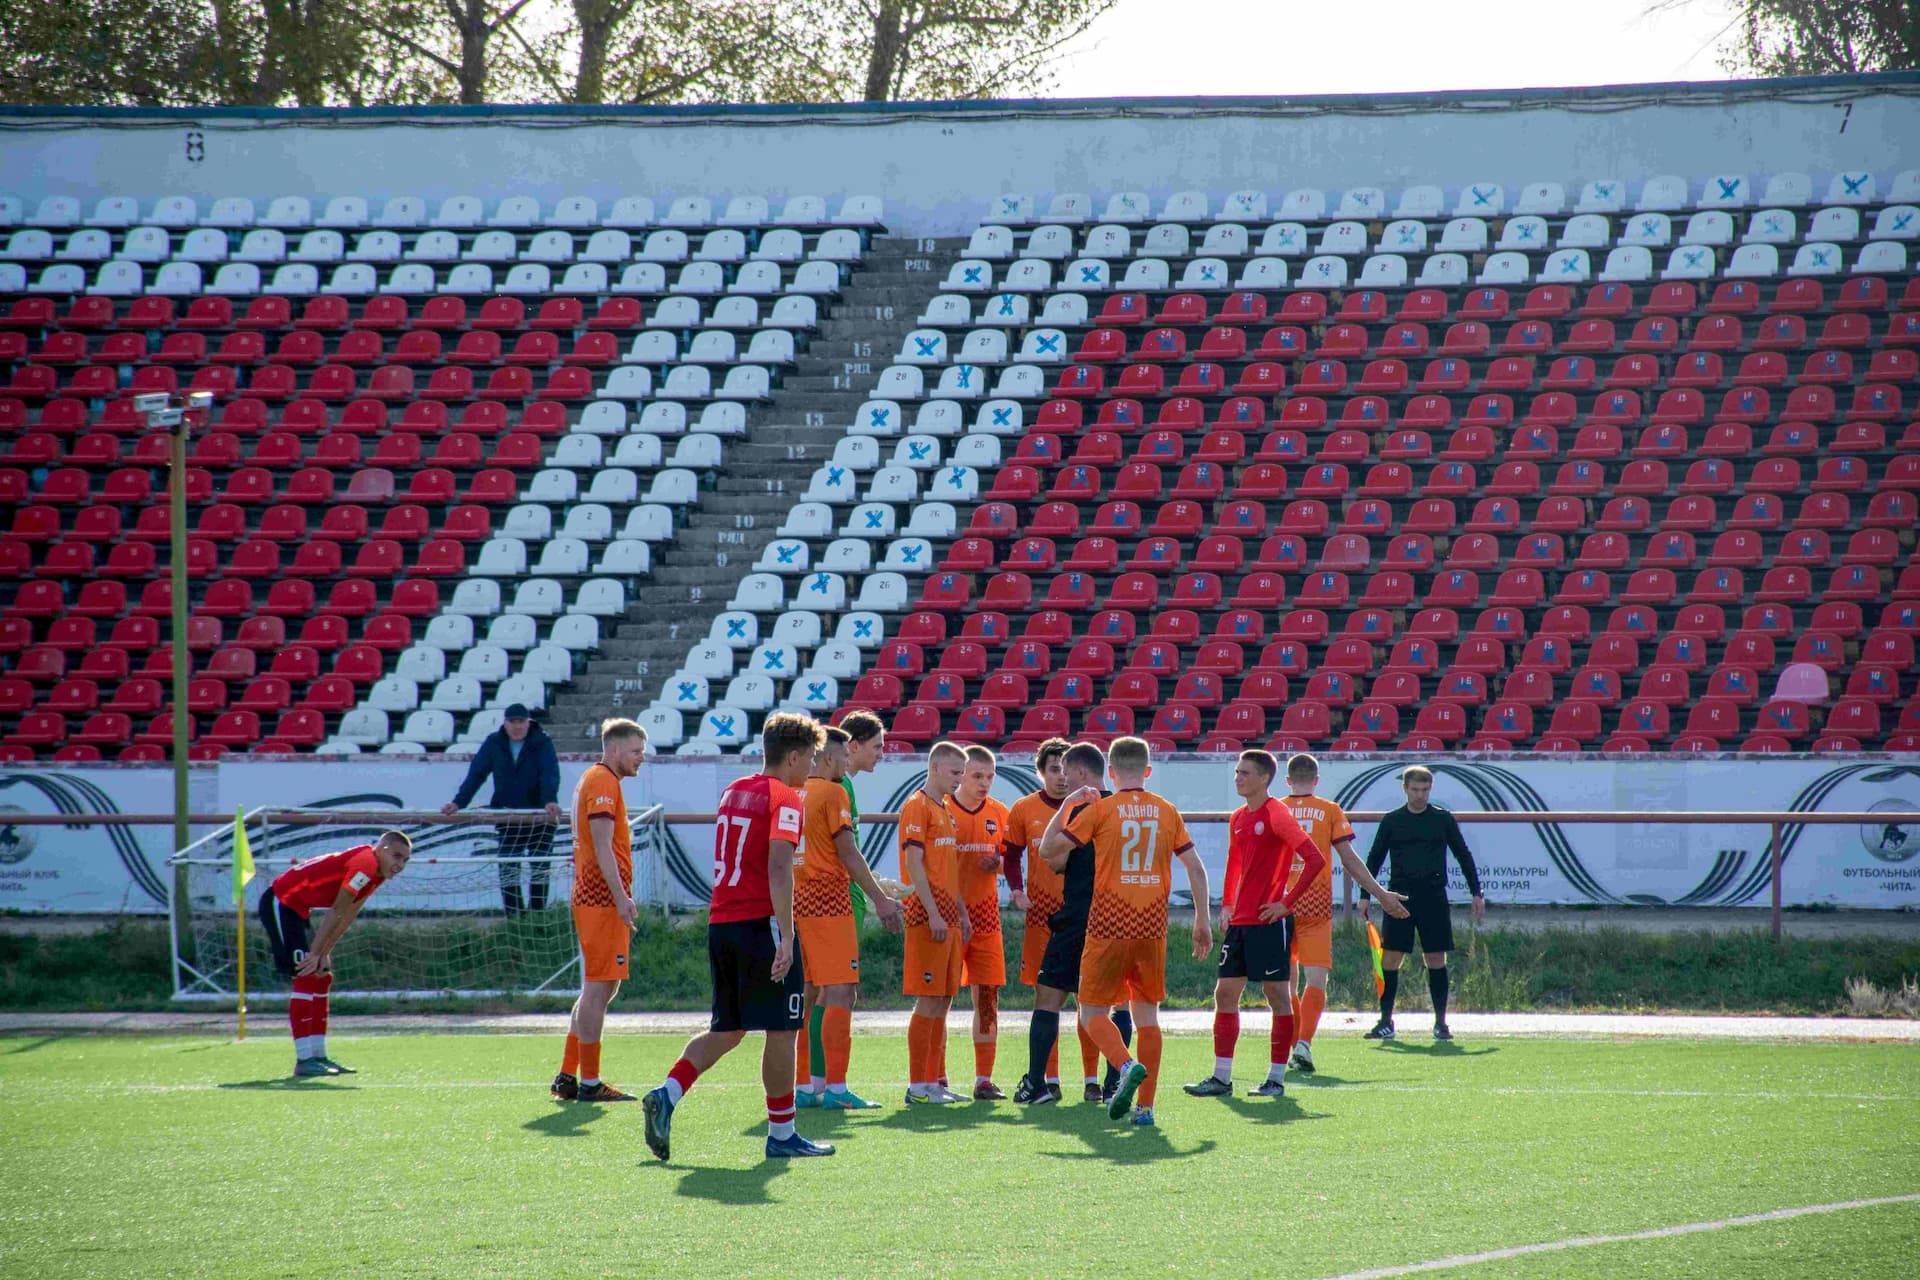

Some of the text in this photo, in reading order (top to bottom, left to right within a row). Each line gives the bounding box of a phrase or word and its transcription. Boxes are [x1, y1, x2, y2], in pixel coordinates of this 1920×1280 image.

[1833, 103, 1853, 134] 7
[186, 132, 205, 162] 8
[1339, 226, 1351, 235] 22
[917, 239, 935, 253] 18
[1023, 266, 1034, 276] 27
[1300, 295, 1312, 305] 22
[1362, 291, 1371, 303] 21
[876, 307, 893, 320] 16
[1339, 328, 1349, 337] 21
[980, 337, 991, 347] 27
[854, 343, 871, 356] 15
[895, 372, 907, 381] 28
[806, 413, 823, 427] 13
[1158, 432, 1169, 441] 23
[1279, 436, 1289, 445] 21
[786, 446, 805, 460] 12
[1134, 464, 1147, 475] 23
[1260, 469, 1271, 478] 21
[889, 475, 901, 485] 27
[767, 480, 782, 496] 11
[1052, 504, 1064, 513] 24
[1114, 503, 1126, 513] 23
[1176, 504, 1187, 514] 22
[1301, 506, 1314, 516] 20
[735, 515, 754, 527] 10
[1006, 573, 1017, 583] 24
[1194, 578, 1204, 588] 21
[1322, 577, 1334, 585] 19
[1451, 574, 1462, 585] 17
[1132, 581, 1144, 591] 22
[1259, 579, 1271, 588] 20
[919, 615, 931, 624] 25
[983, 614, 993, 624] 24
[1045, 611, 1057, 622] 23
[1109, 612, 1119, 622] 22
[1236, 614, 1248, 624] 20
[1301, 614, 1313, 624] 19
[1432, 613, 1441, 623] 17
[792, 619, 804, 628] 27
[670, 625, 679, 638] 7
[1410, 643, 1420, 652] 17
[1543, 640, 1553, 650] 15
[1217, 649, 1229, 658] 20
[872, 676, 884, 686] 25
[1261, 677, 1272, 687] 19
[1396, 677, 1405, 688] 17
[1460, 676, 1472, 685] 16
[745, 682, 758, 692] 27
[977, 705, 989, 716] 23
[1173, 709, 1185, 719] 20
[1236, 710, 1249, 720] 19
[1370, 708, 1380, 718] 17
[1042, 711, 1055, 721] 22
[1483, 743, 1494, 752] 15
[1117, 804, 1159, 819] ЖДАНОВ
[1121, 820, 1159, 872] 27
[1493, 865, 1549, 878] КУЛЬТУРЫ
[1502, 880, 1530, 890] КРАЯ
